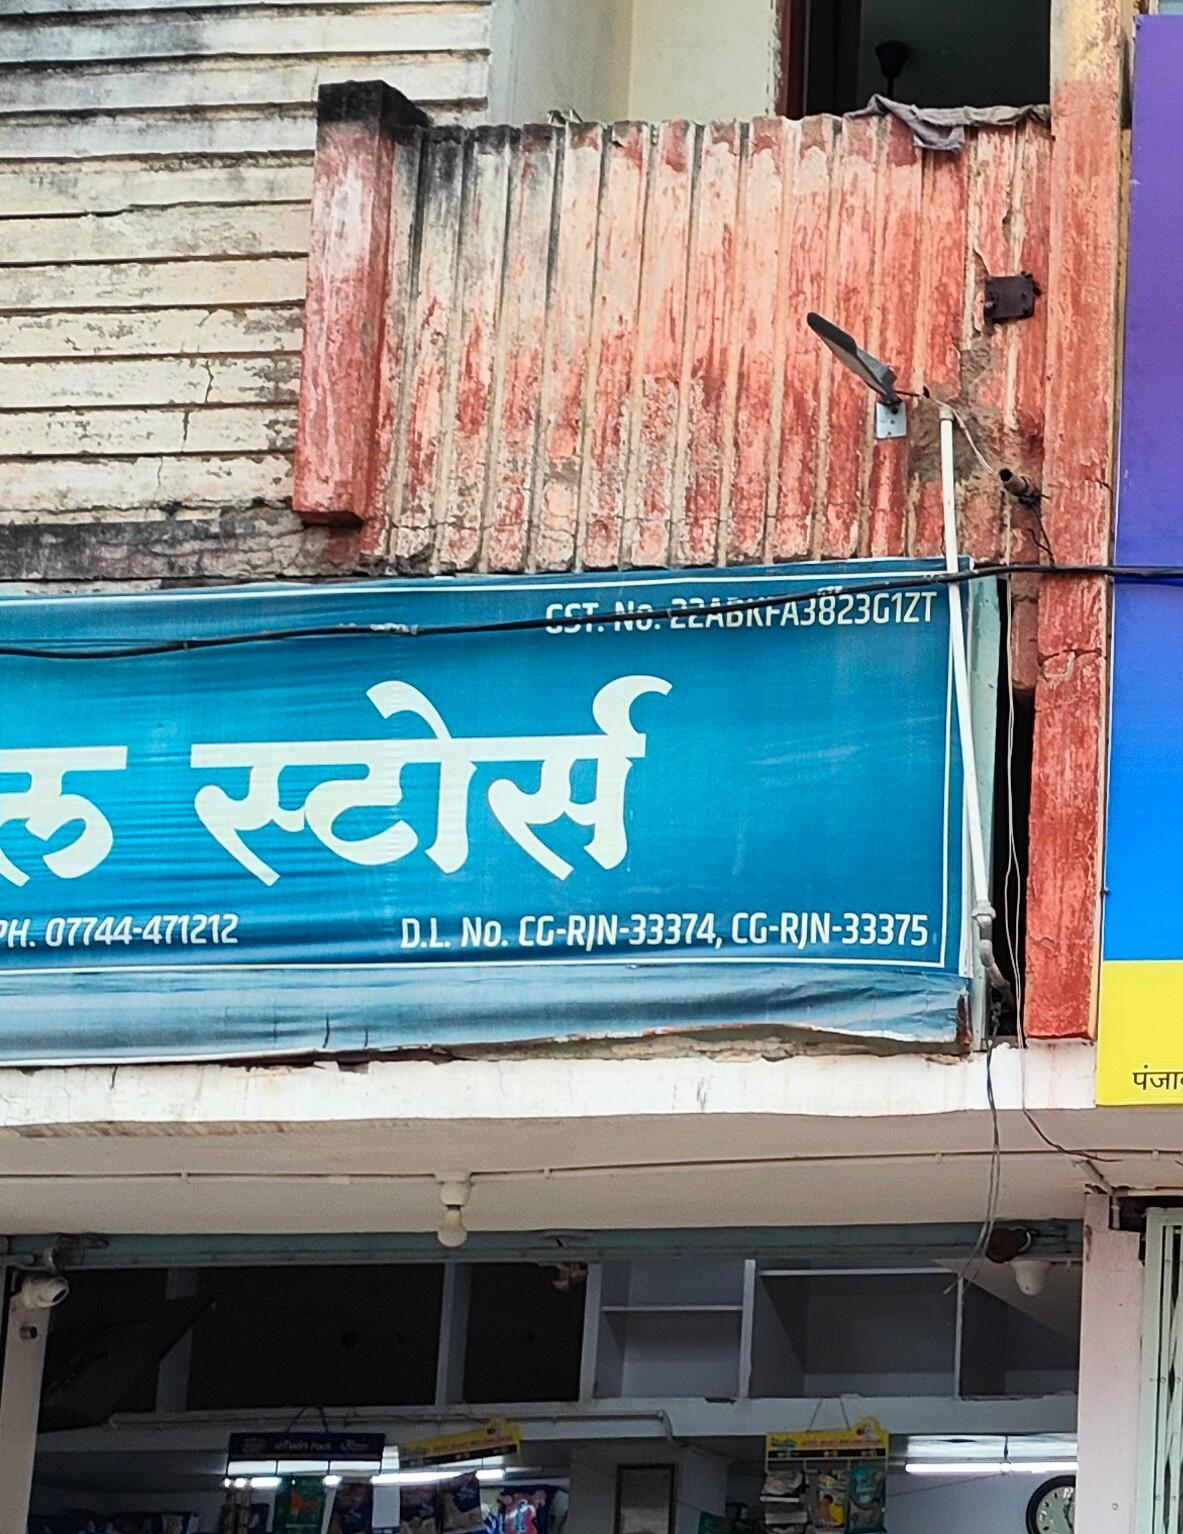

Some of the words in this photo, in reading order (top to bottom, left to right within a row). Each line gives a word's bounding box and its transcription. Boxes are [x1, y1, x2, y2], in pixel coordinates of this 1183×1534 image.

[615, 601, 660, 631] No.
[191, 676, 672, 885] स्टोर्स
[46, 914, 238, 946] 07744-471212
[400, 918, 451, 948] D.L.
[461, 917, 508, 947] No.
[519, 913, 722, 951] CG-RJN-33374,
[732, 913, 927, 949] CG-RJN-33375
